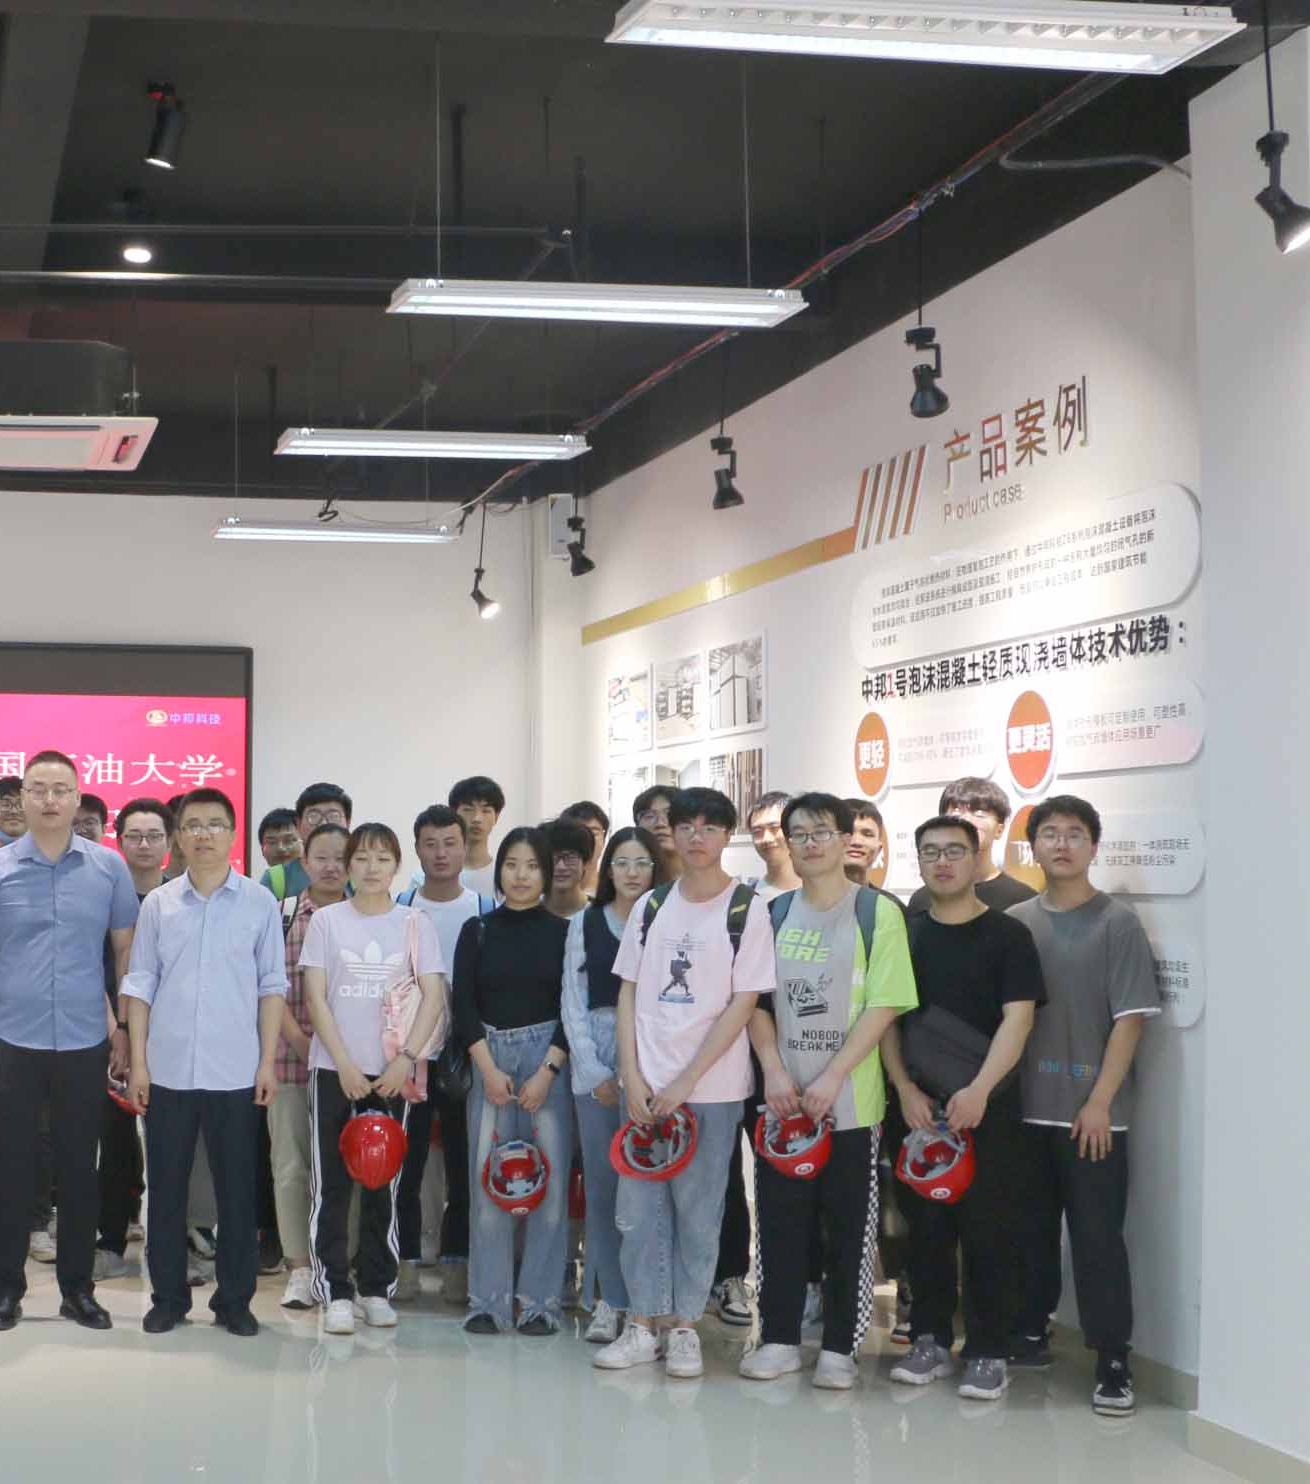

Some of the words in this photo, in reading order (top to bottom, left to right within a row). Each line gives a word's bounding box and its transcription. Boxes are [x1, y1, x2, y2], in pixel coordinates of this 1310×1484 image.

[943, 375, 1091, 494] 产品案例
[858, 739, 885, 771] 更轻
[339, 980, 385, 998] adid
